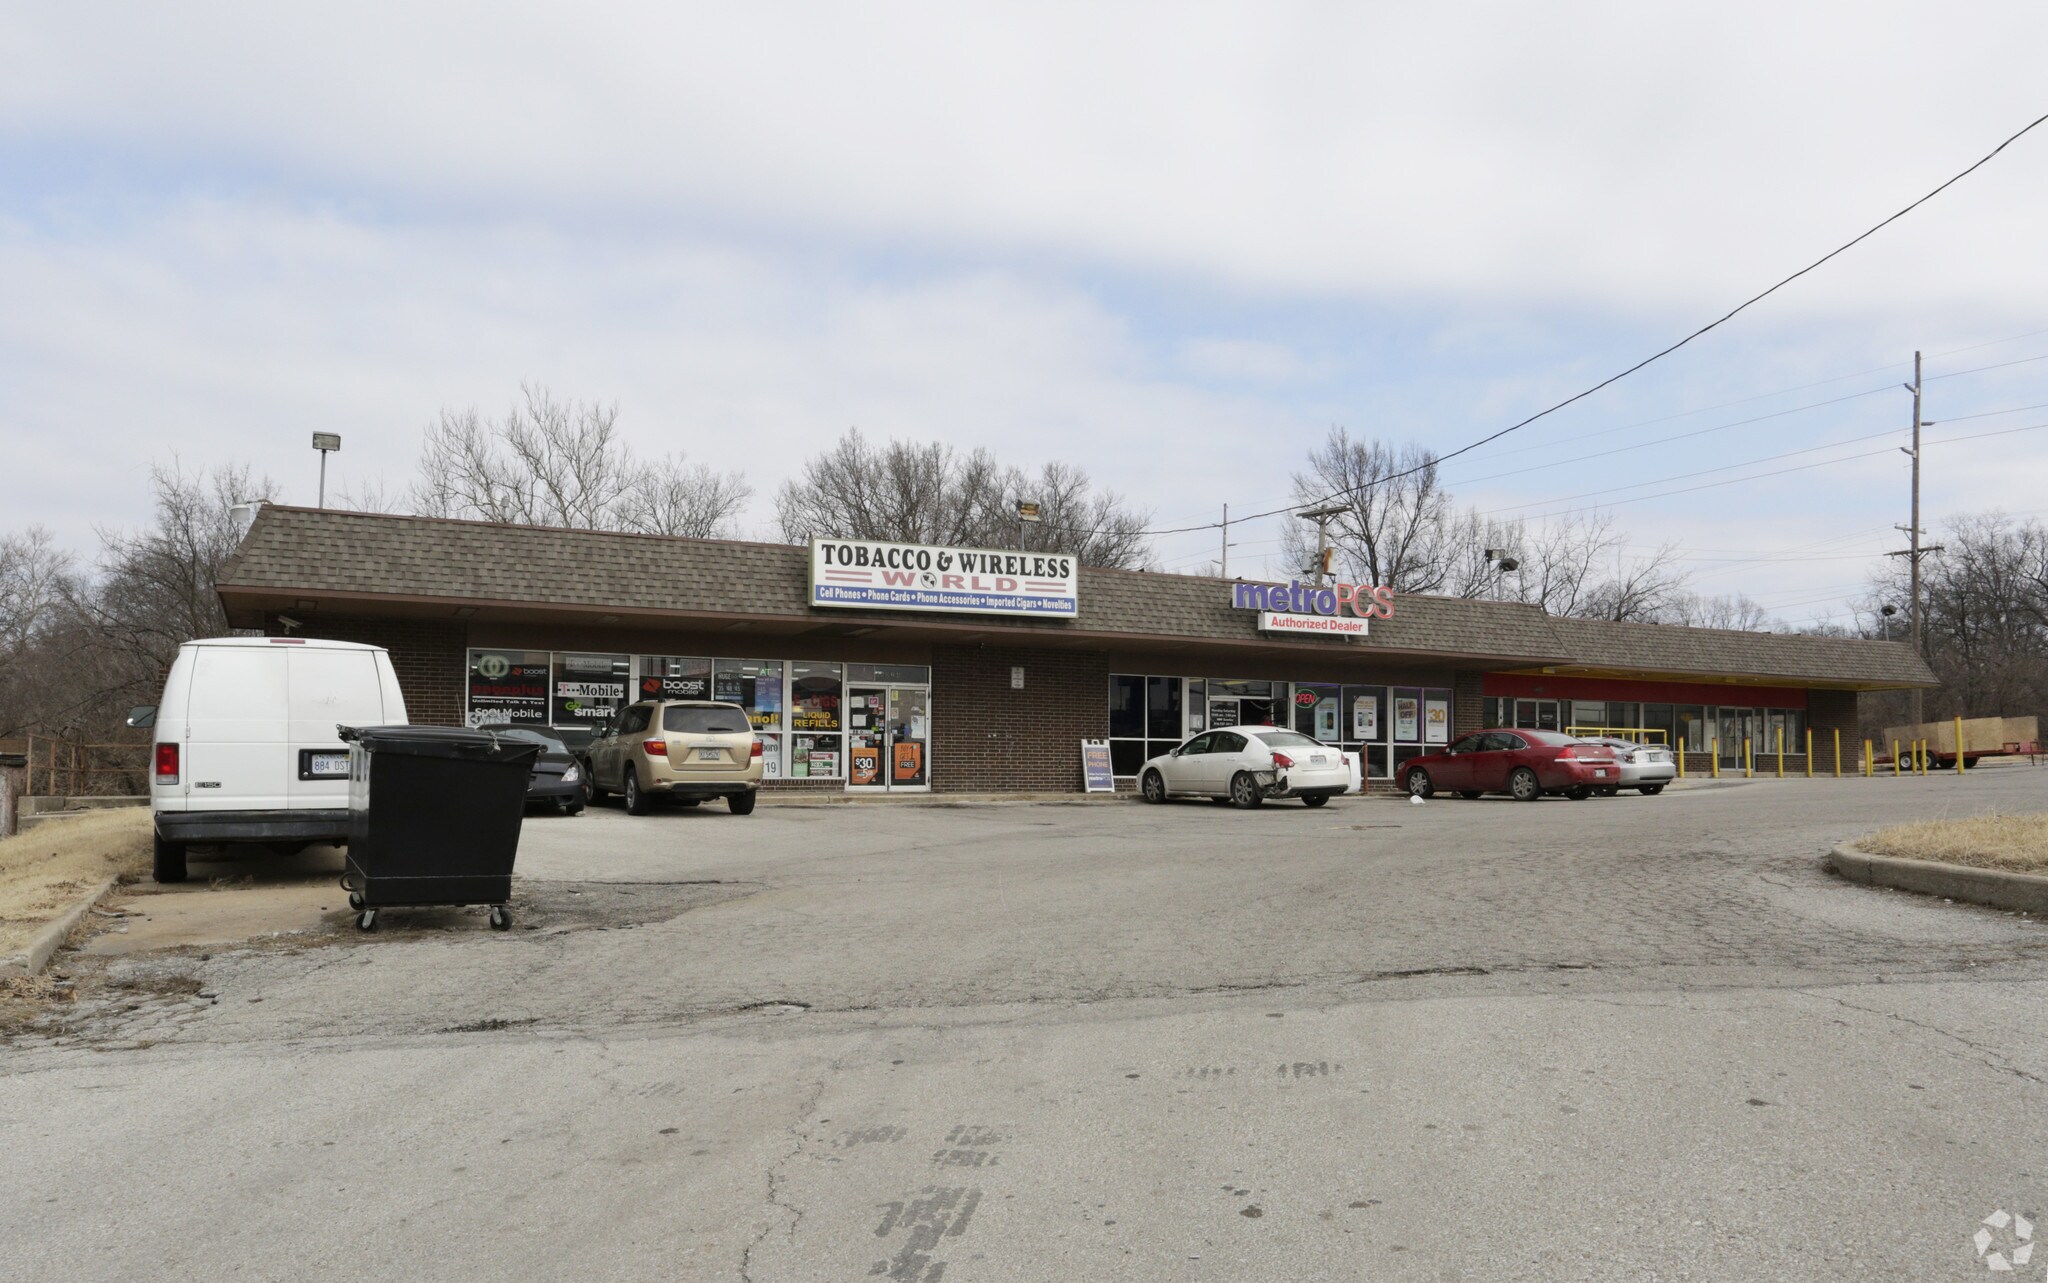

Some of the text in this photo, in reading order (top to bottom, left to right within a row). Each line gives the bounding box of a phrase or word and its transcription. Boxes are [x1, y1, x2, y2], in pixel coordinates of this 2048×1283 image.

[822, 544, 1070, 578] TOBACCO & WIRELESS
[881, 570, 1018, 592] WORLD
[820, 586, 1072, 610] Cell Phones Phone Cards Phone Accessories Imported Cigars Novelties
[1234, 579, 1395, 619] metroPCS
[1271, 616, 1363, 632] Authorized Dealer
[662, 678, 704, 690] boost
[1296, 693, 1316, 704] OPEN
[574, 707, 616, 718] smart
[794, 720, 838, 728] REFILLS
[1087, 751, 1108, 760] FREE
[314, 760, 330, 771] 884
[766, 762, 776, 773] 19
[856, 758, 872, 768] $30
